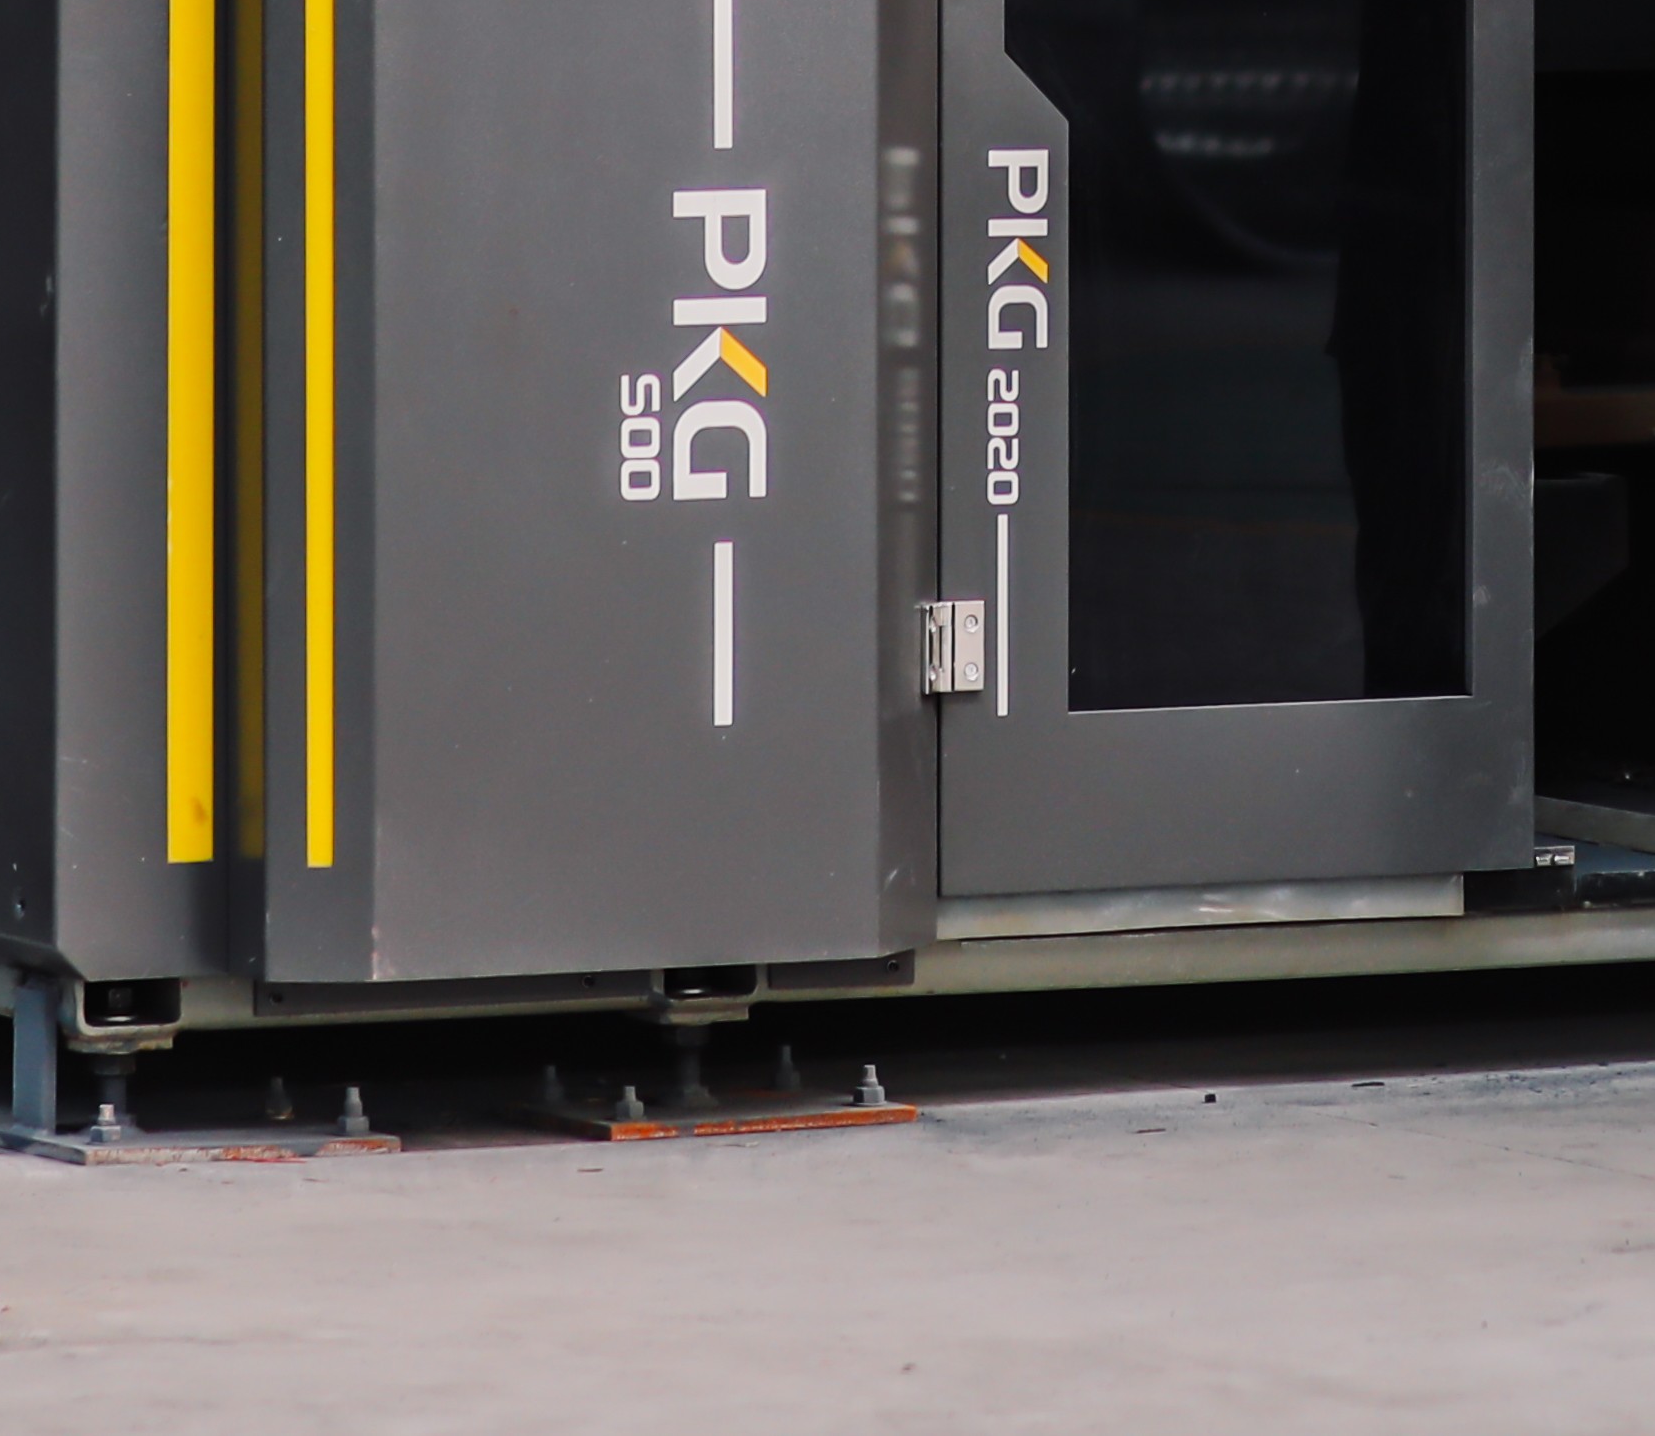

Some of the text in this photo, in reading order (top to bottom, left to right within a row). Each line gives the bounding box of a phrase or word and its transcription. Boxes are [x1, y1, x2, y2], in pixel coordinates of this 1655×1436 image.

[673, 189, 771, 502] PKG
[988, 149, 1052, 506] PKG 2020
